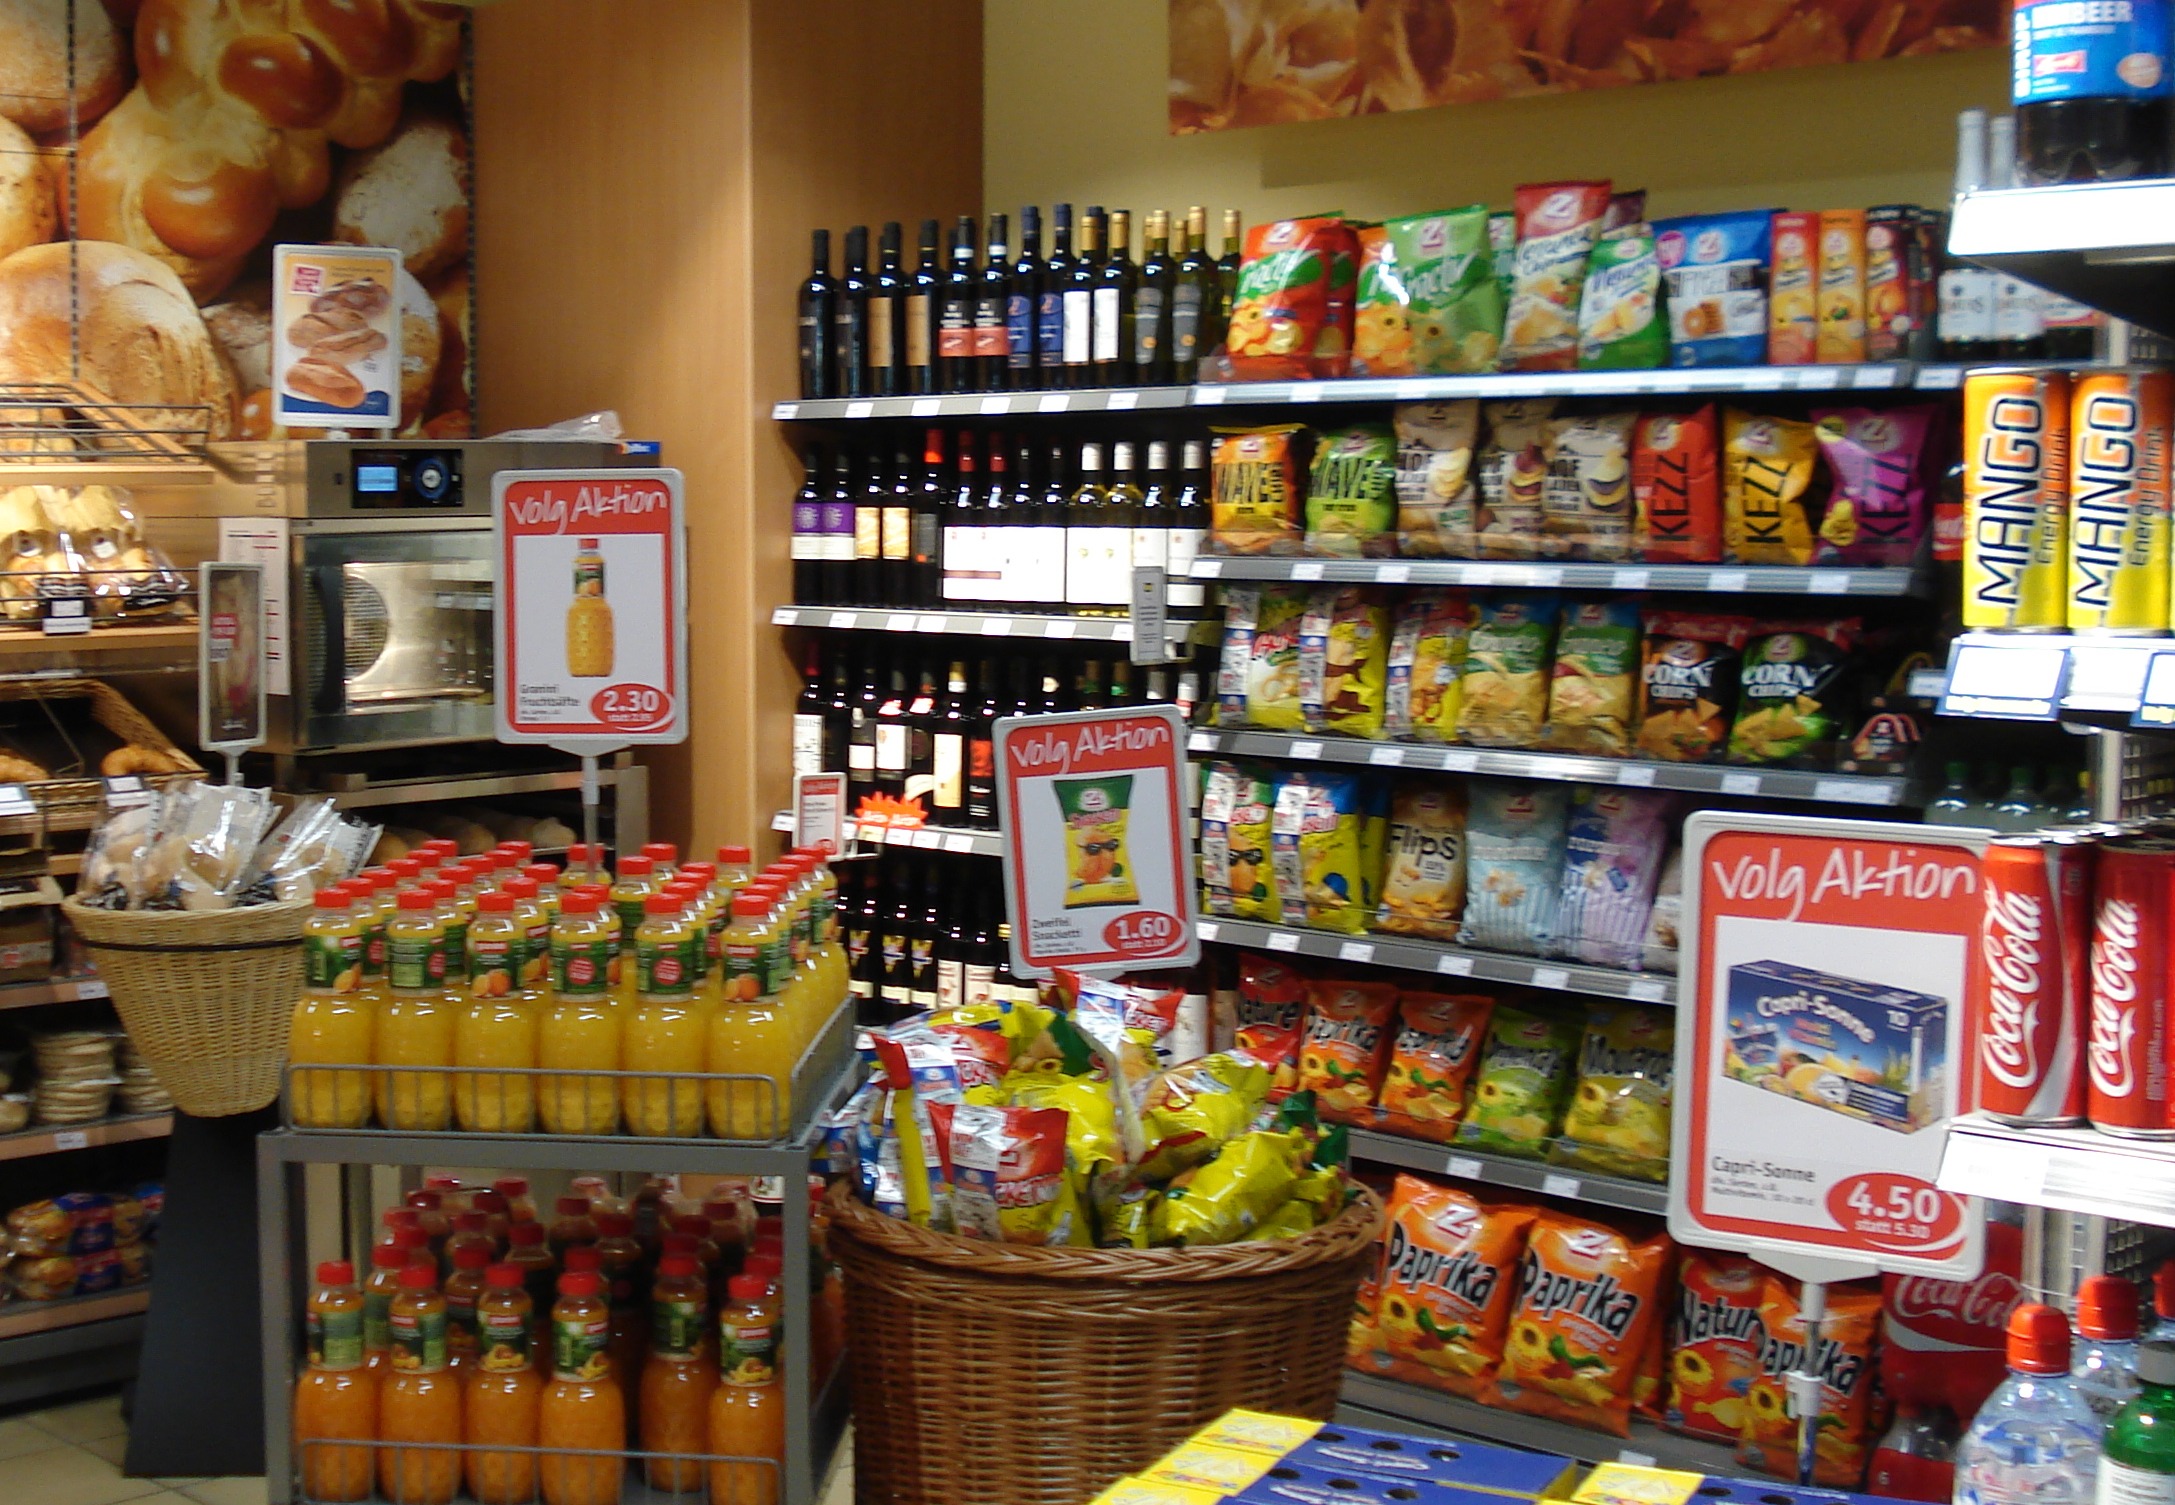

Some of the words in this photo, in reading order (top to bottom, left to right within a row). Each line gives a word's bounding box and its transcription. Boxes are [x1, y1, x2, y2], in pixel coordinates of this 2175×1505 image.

[510, 490, 568, 534] Volg
[570, 484, 668, 522] Aktion
[1977, 395, 2042, 605] MANGO
[2074, 395, 2137, 606] MANGO
[1642, 660, 1717, 687] CORN
[1741, 662, 1826, 688] CORN
[602, 690, 660, 712] 2.30
[1011, 732, 1070, 774] Volg
[1073, 722, 1169, 762] Aktion
[1389, 822, 1457, 867] Flips
[1712, 847, 1806, 921] Volg
[1810, 847, 1977, 904] Aktion
[1115, 916, 1172, 940] 1.60
[1756, 989, 1876, 1044] Capri-Sonne
[1712, 1156, 1817, 1183] Capri-Sonne
[1846, 1180, 1942, 1224] 4.50
[1854, 1219, 1892, 1235] statt
[1385, 1220, 1500, 1314] Paprika
[1520, 1246, 1642, 1341] Paprika
